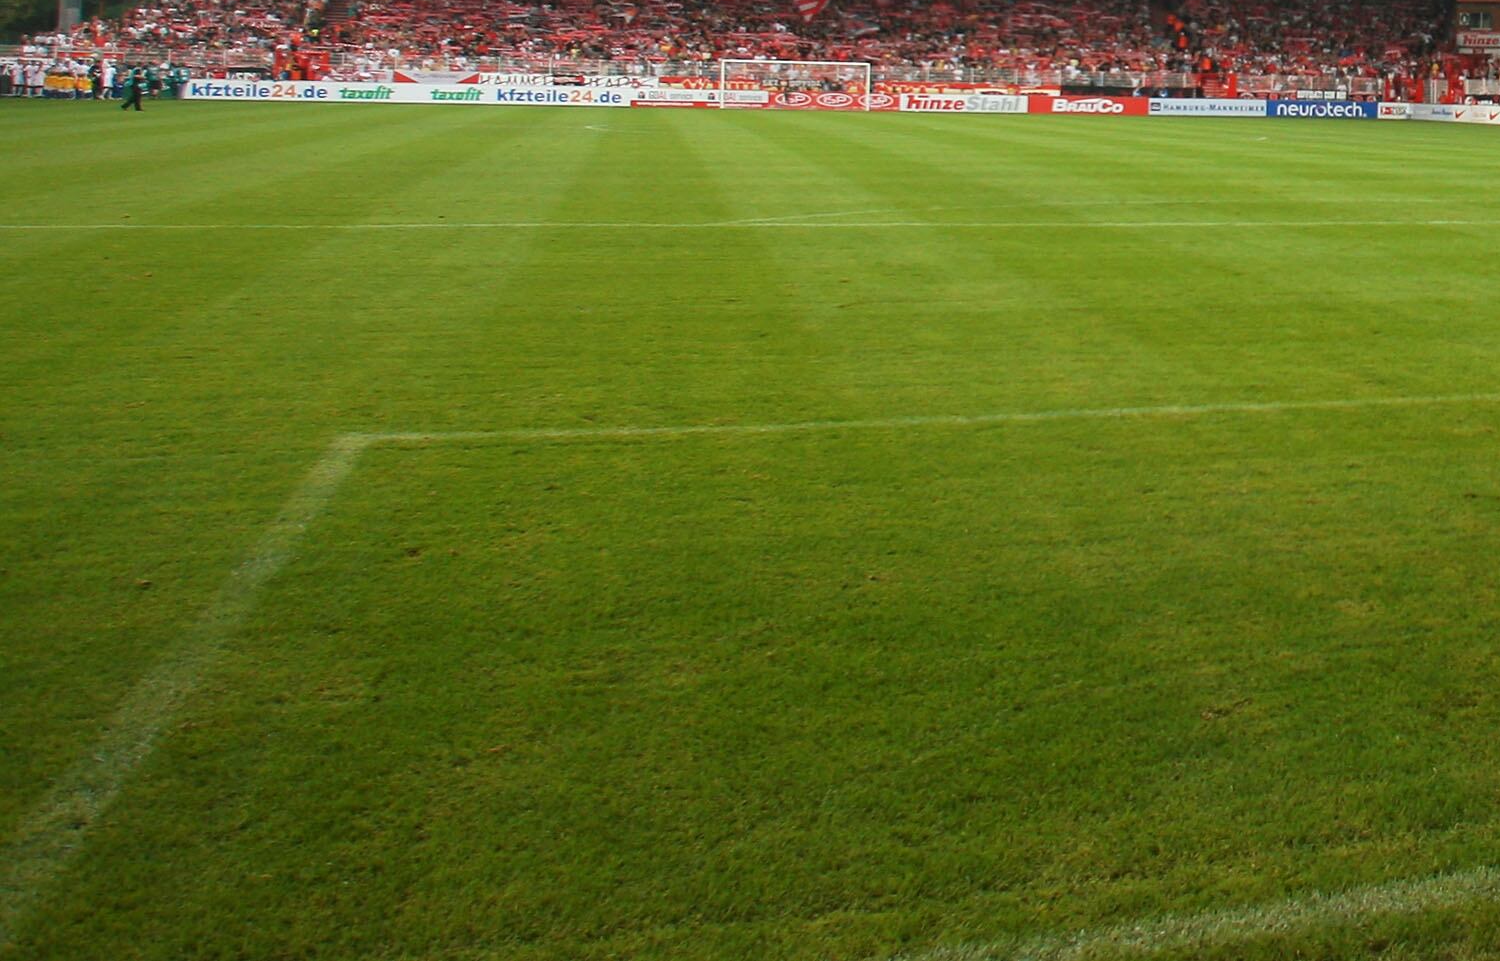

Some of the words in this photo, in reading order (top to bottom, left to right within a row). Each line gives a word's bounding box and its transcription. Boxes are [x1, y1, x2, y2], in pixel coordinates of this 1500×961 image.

[192, 83, 328, 99] kfzteile24.de
[340, 85, 394, 100] taxofit
[430, 87, 484, 101] taxofit
[497, 89, 622, 103] kfzteile24.de
[1277, 102, 1367, 118] neurotech.
